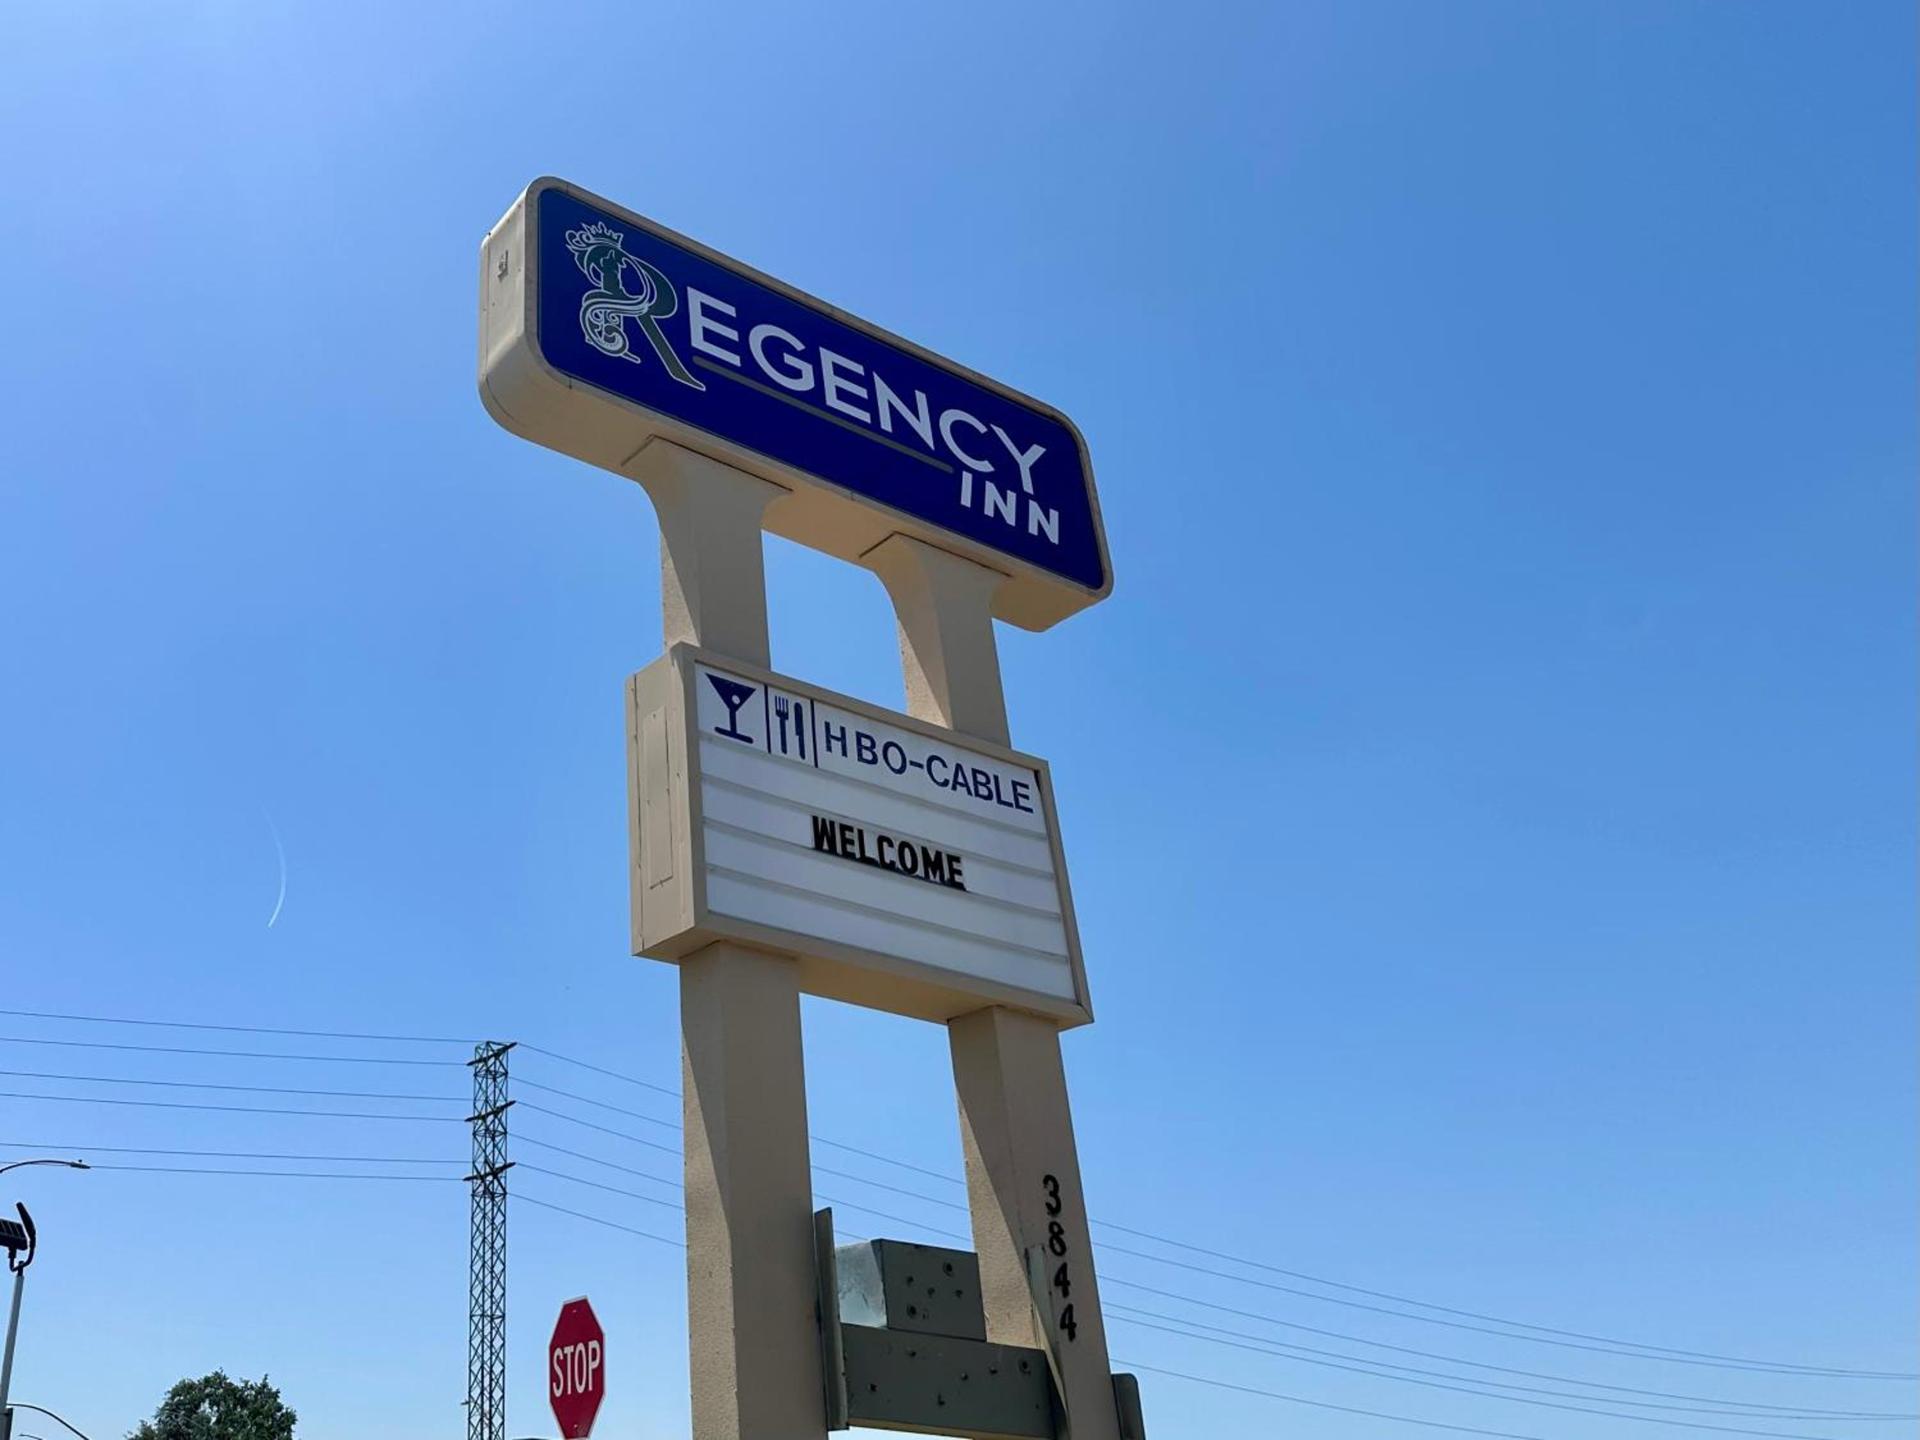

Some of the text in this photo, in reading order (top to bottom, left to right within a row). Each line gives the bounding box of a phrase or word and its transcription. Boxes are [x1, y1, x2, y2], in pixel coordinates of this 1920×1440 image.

[564, 221, 1046, 494] REGENCY
[959, 471, 1059, 545] INN
[824, 720, 1034, 813] HBO-CABLE
[811, 815, 967, 891] WELCOME
[1042, 1174, 1077, 1342] 3844
[552, 1340, 601, 1398] STOP
